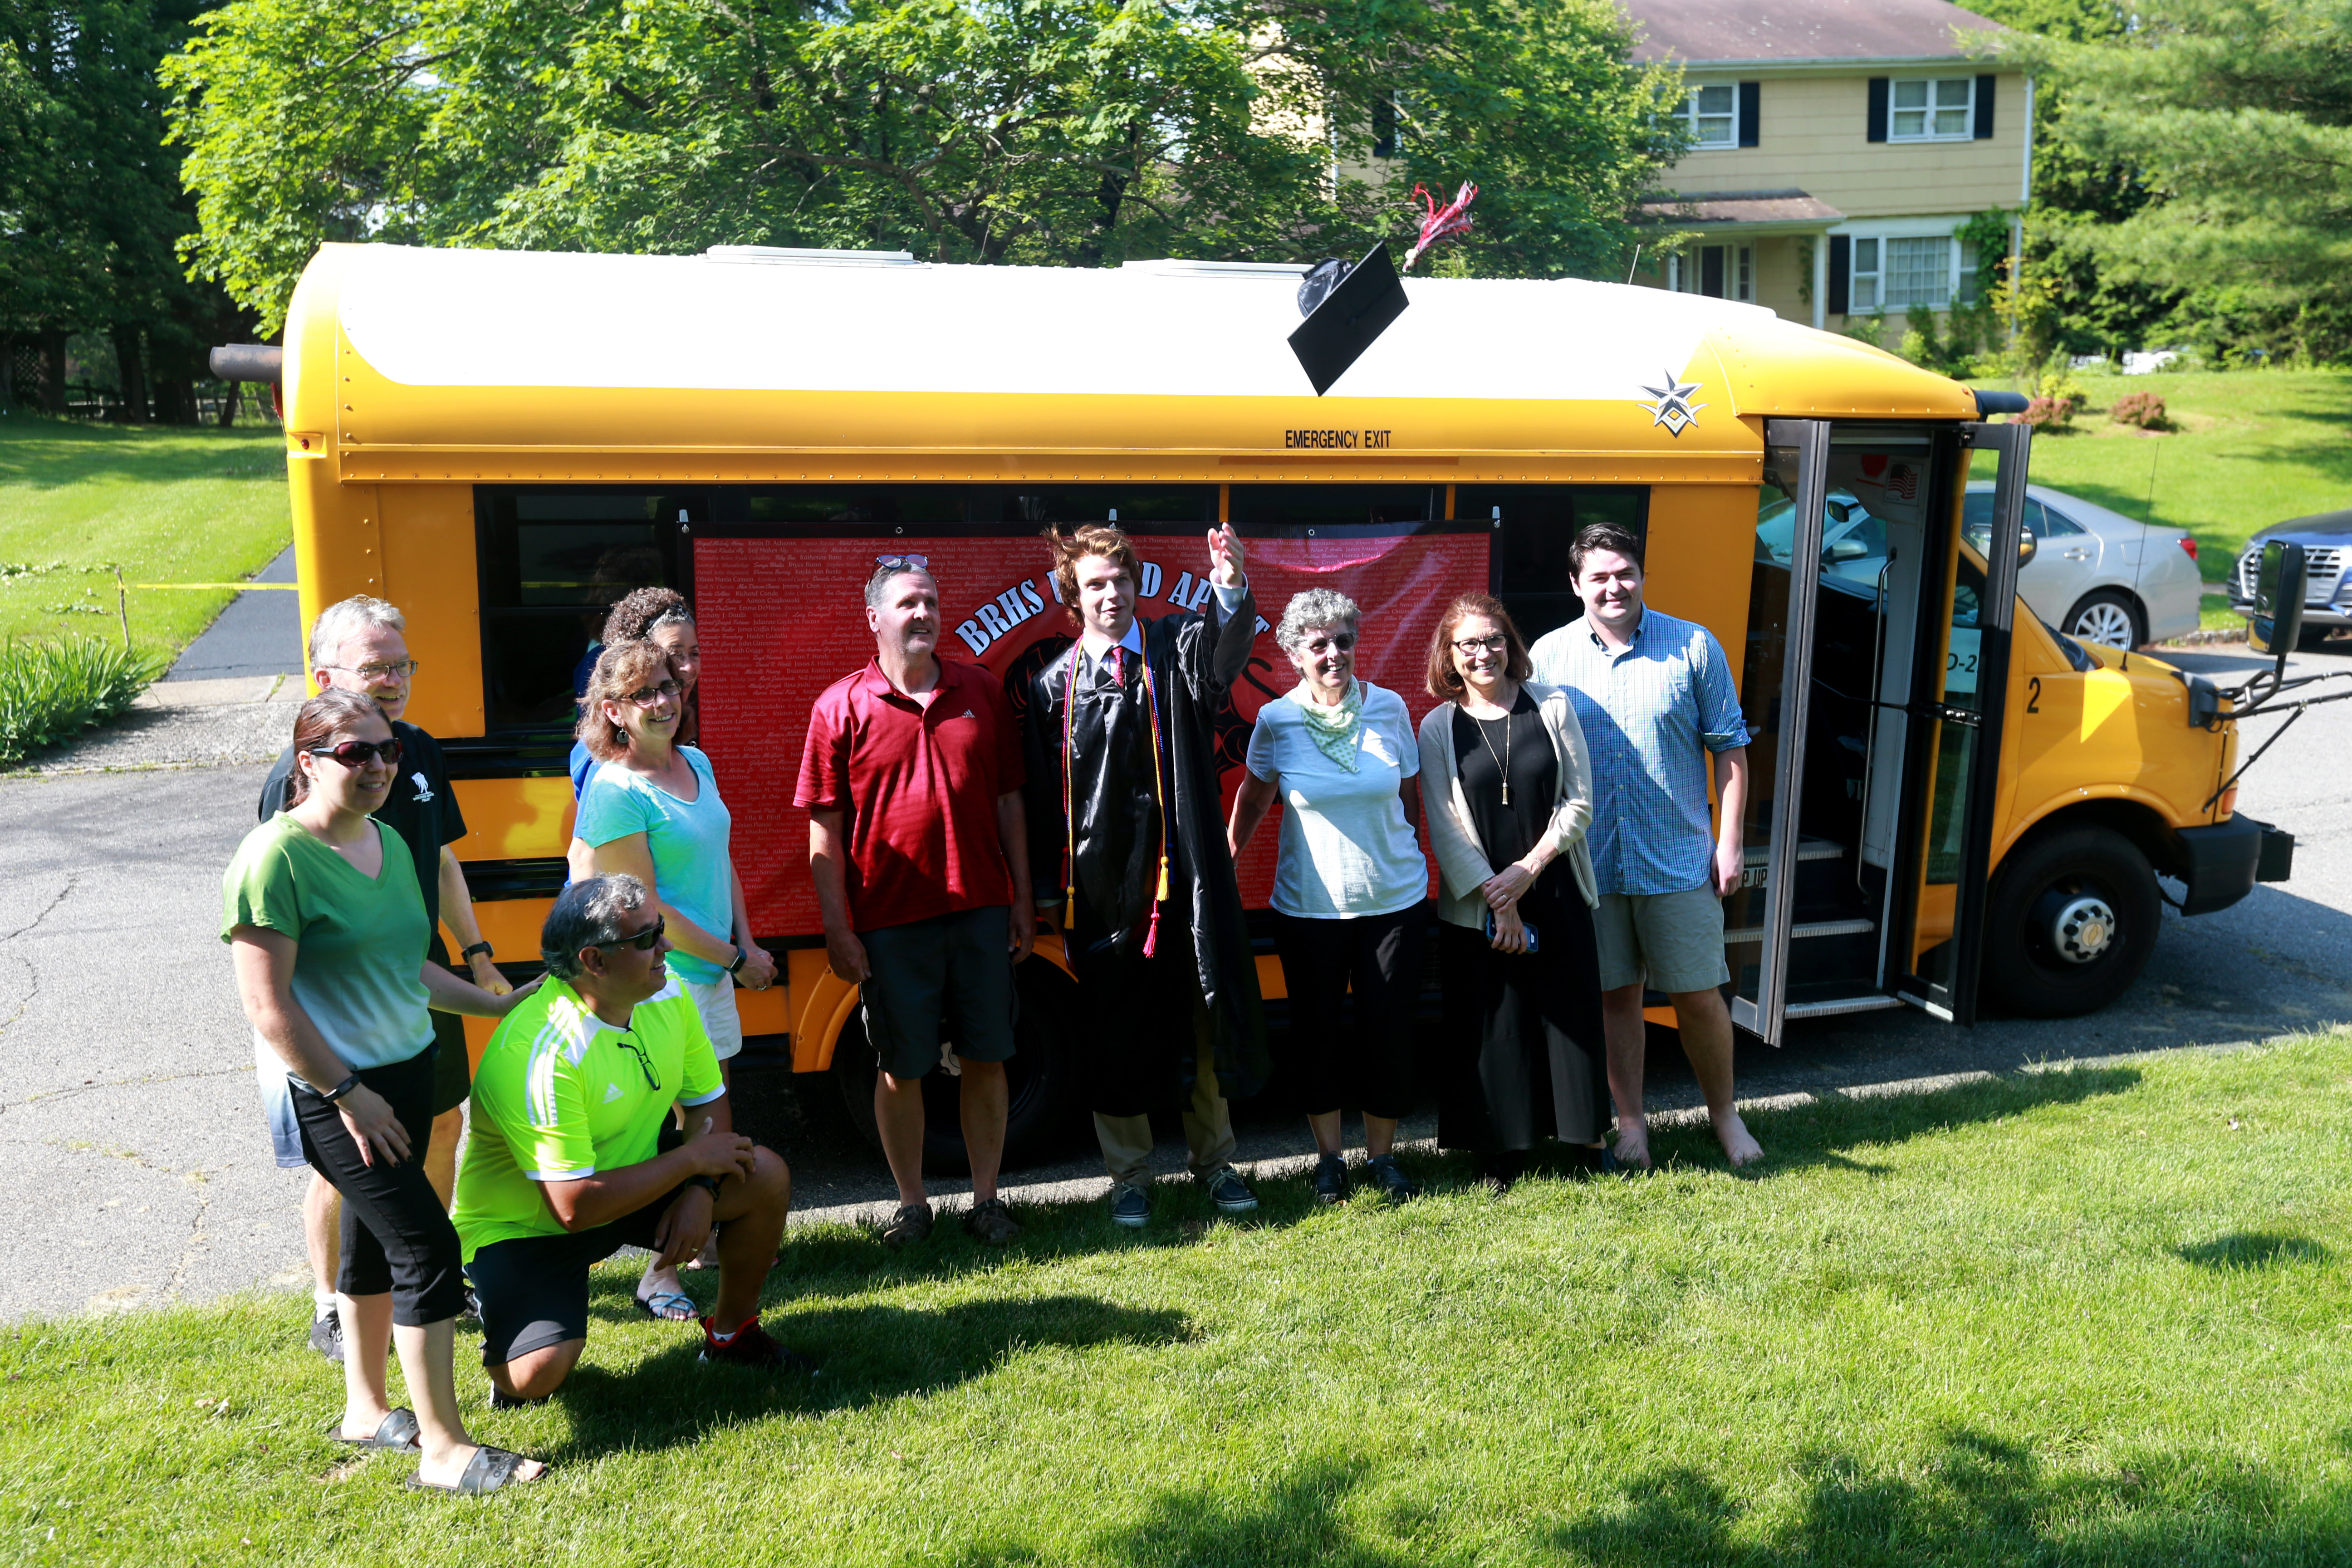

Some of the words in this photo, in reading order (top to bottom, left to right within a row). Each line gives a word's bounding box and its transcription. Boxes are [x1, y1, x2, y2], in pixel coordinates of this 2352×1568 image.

[1285, 430, 1358, 448] EMERGENCY
[1365, 430, 1391, 448] EXIT
[955, 578, 1044, 657] BRHS
[2027, 677, 2040, 713] 2
